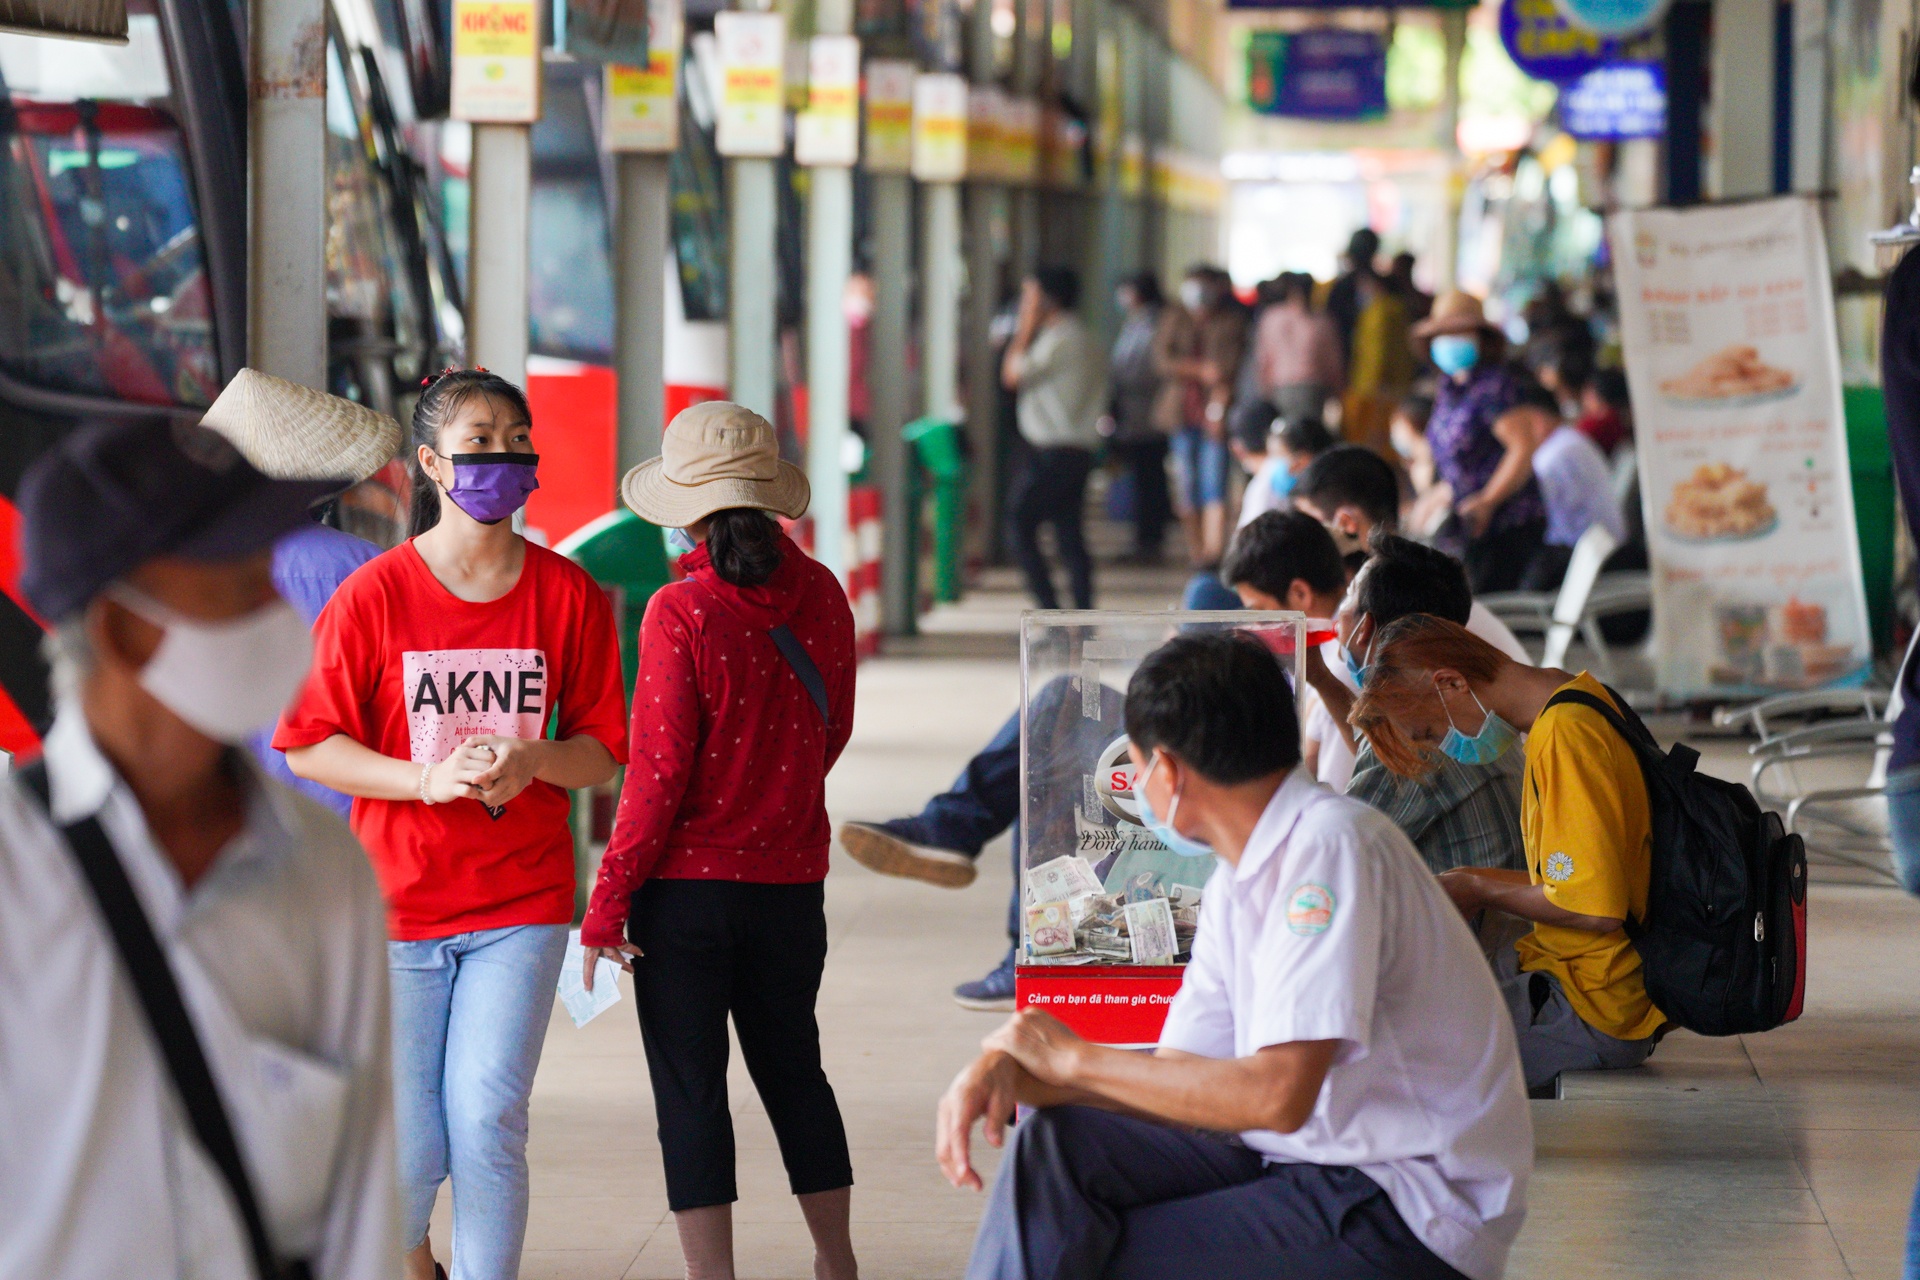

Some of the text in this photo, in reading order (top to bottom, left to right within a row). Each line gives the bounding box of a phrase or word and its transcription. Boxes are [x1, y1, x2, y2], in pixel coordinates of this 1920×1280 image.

[412, 671, 543, 714] AKNE
[455, 726, 496, 736] At that time
[1028, 993, 1050, 1004] Cảm
[1053, 994, 1065, 1004] ơn
[1068, 994, 1086, 1006] bạn
[1089, 993, 1101, 1004] đã
[1104, 994, 1128, 1004] tham
[1131, 994, 1146, 1006] gia
